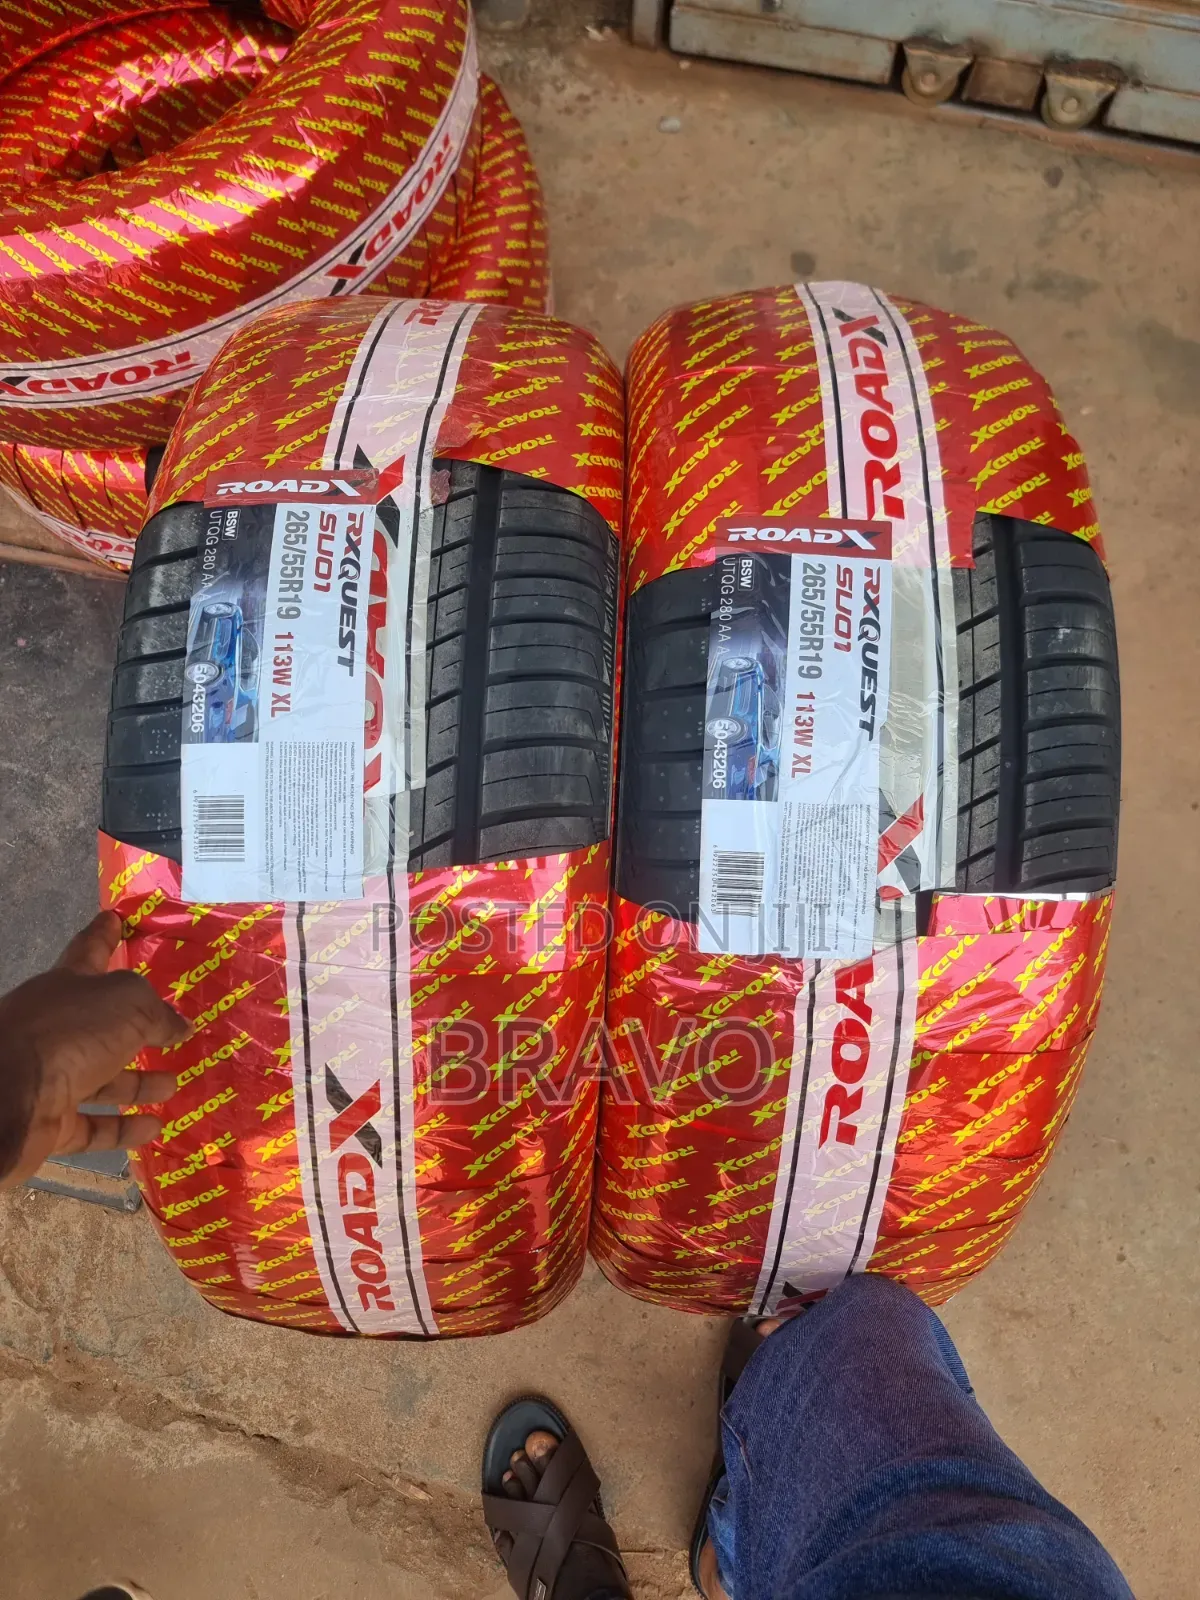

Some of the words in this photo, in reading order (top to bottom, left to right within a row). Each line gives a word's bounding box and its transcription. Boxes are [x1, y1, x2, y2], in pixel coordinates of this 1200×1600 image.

[324, 95, 385, 118] ROADX
[310, 196, 361, 221] ROADX
[325, 132, 452, 297] ROADX
[250, 233, 309, 260] ROADX
[180, 262, 245, 293] ROADX
[107, 282, 178, 318] ROADX
[968, 377, 1033, 412] ROADX
[833, 307, 905, 521] ROADX
[170, 411, 259, 479] ROADX
[967, 436, 1046, 493] ROADX
[216, 479, 363, 497] ROADX
[661, 460, 743, 540] ROADX
[205, 510, 223, 545] UTQG
[225, 510, 239, 538] BSW
[727, 527, 880, 550] ROADX
[203, 548, 217, 570] 280
[277, 510, 310, 620] 265/55R19
[720, 557, 736, 594] UTQG
[740, 559, 753, 587] BSW
[201, 573, 214, 589] AA
[338, 511, 365, 677] RXQUEST
[719, 598, 732, 620] 280
[798, 562, 826, 679] 265/55R19
[718, 624, 730, 642] AA
[718, 646, 730, 655] A
[272, 631, 294, 686] 113W
[857, 566, 881, 741] RXQUEST
[190, 664, 207, 733] 5043206
[271, 692, 291, 718] XL
[793, 691, 815, 747] 113W
[712, 719, 729, 789] 5043206
[791, 753, 812, 779] XL
[1006, 953, 1087, 1043] ROADX
[161, 1087, 238, 1143] ROADX
[951, 1076, 1045, 1146] ROADX
[463, 1109, 552, 1180] ROADX
[619, 1145, 699, 1170] ROADX
[160, 1184, 230, 1220] ROADX
[325, 1062, 384, 1312] ROADX
[897, 1174, 989, 1230] ROADX
[447, 1198, 530, 1254] ROADX
